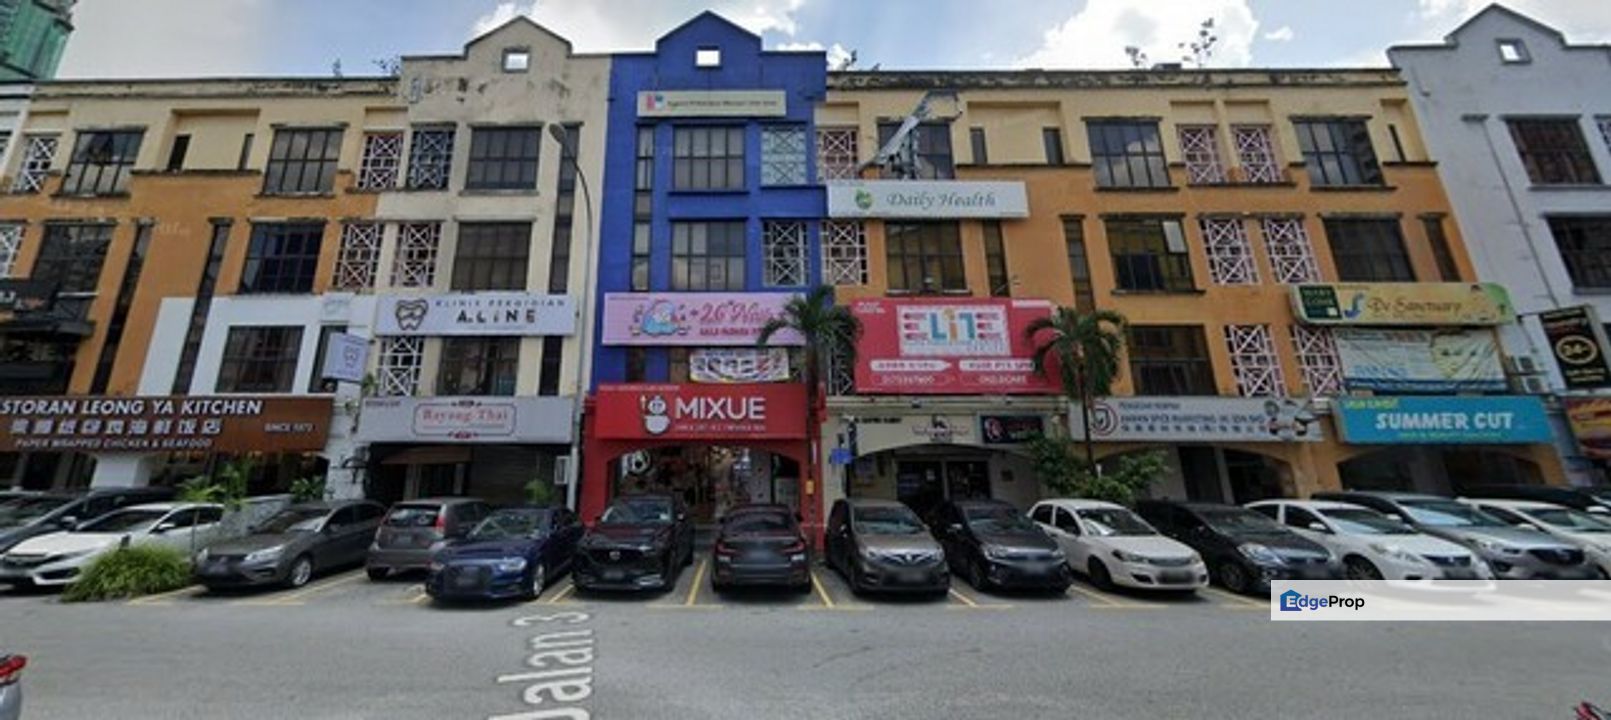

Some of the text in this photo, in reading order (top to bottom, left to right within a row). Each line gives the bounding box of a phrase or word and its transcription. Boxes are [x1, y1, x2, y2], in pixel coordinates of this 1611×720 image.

[886, 189, 997, 209] Daily Health
[81, 400, 145, 414] LEONG
[152, 400, 173, 414] YA
[181, 400, 262, 414] KITCHEN
[675, 397, 766, 419] MIXUE
[1375, 412, 1515, 430] SUMMER CUT
